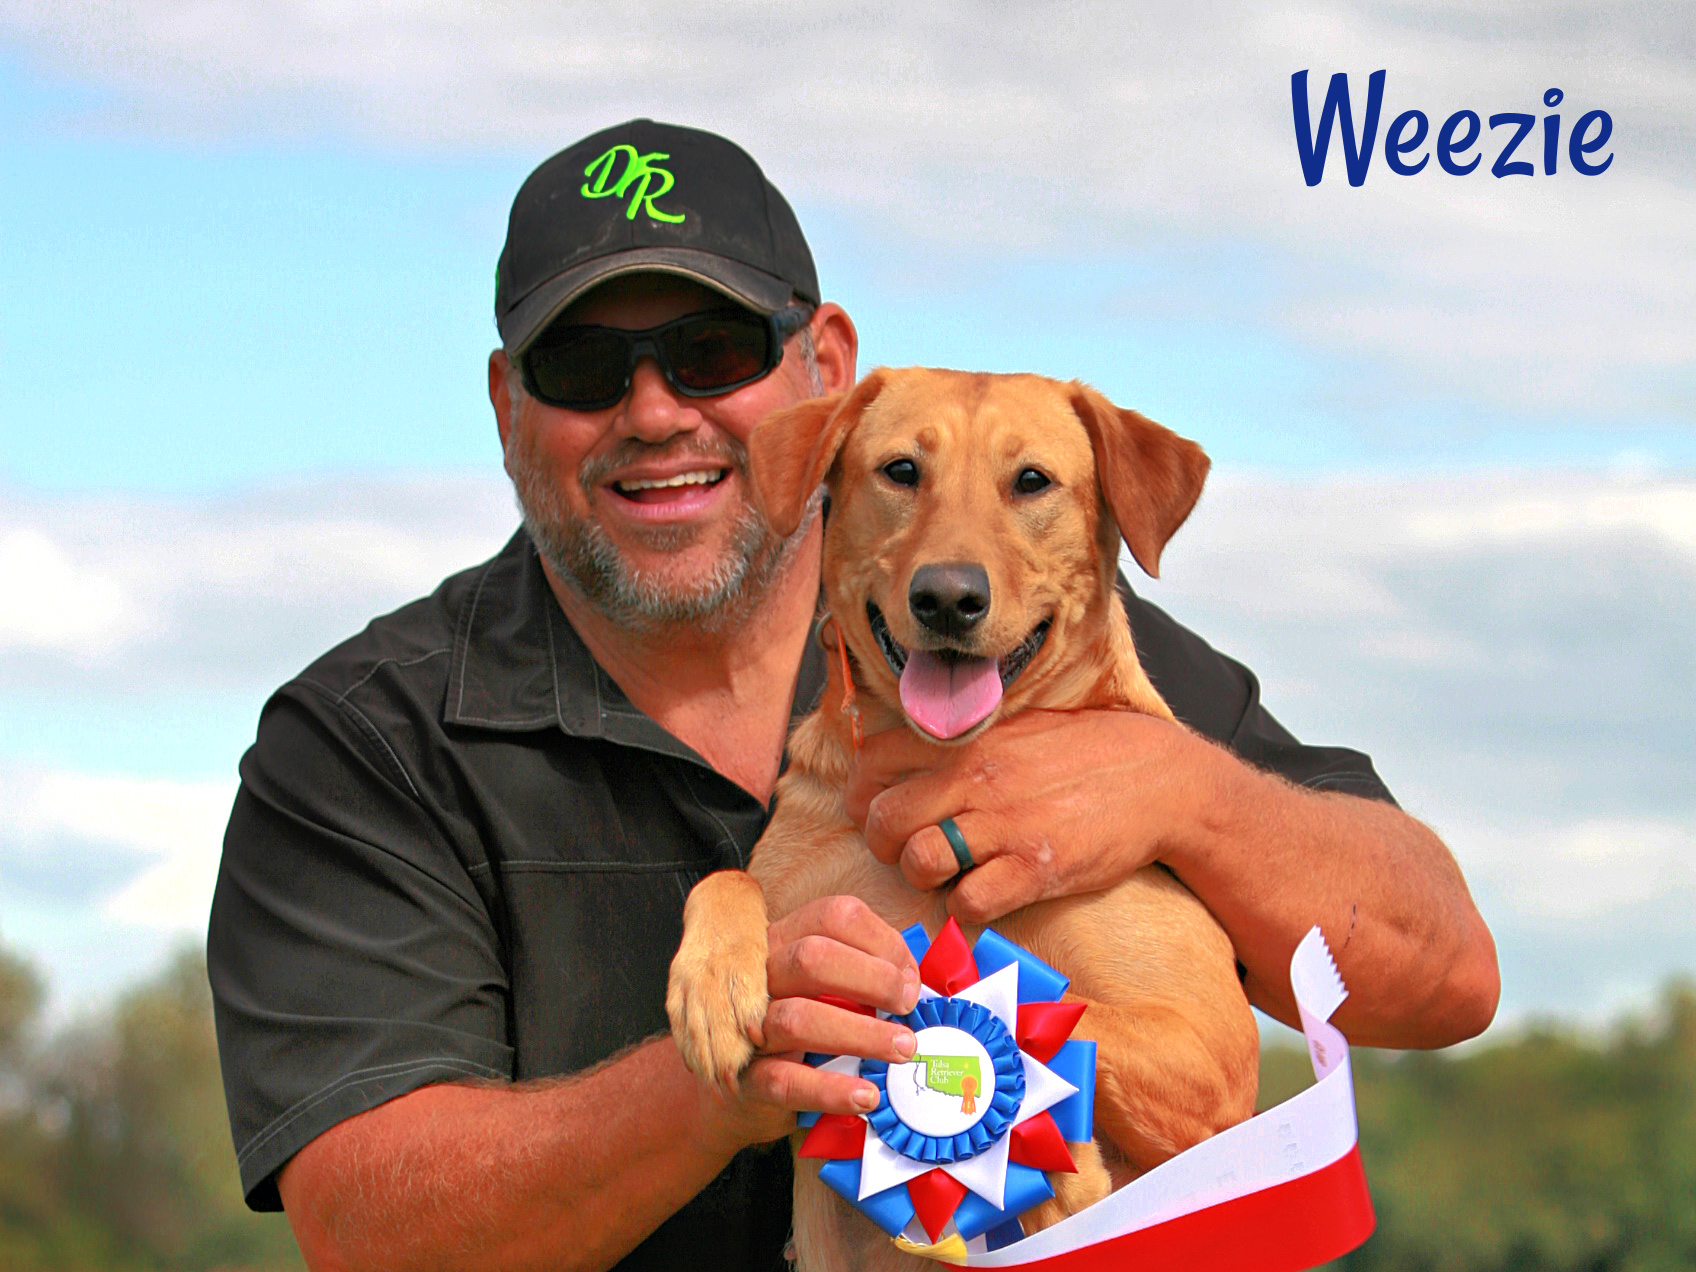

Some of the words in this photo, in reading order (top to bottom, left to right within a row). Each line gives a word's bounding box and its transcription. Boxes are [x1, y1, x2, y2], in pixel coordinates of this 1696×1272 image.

[931, 1059, 949, 1068] Tulsa
[930, 1068, 964, 1076] Retriever
[930, 1076, 949, 1084] Club
